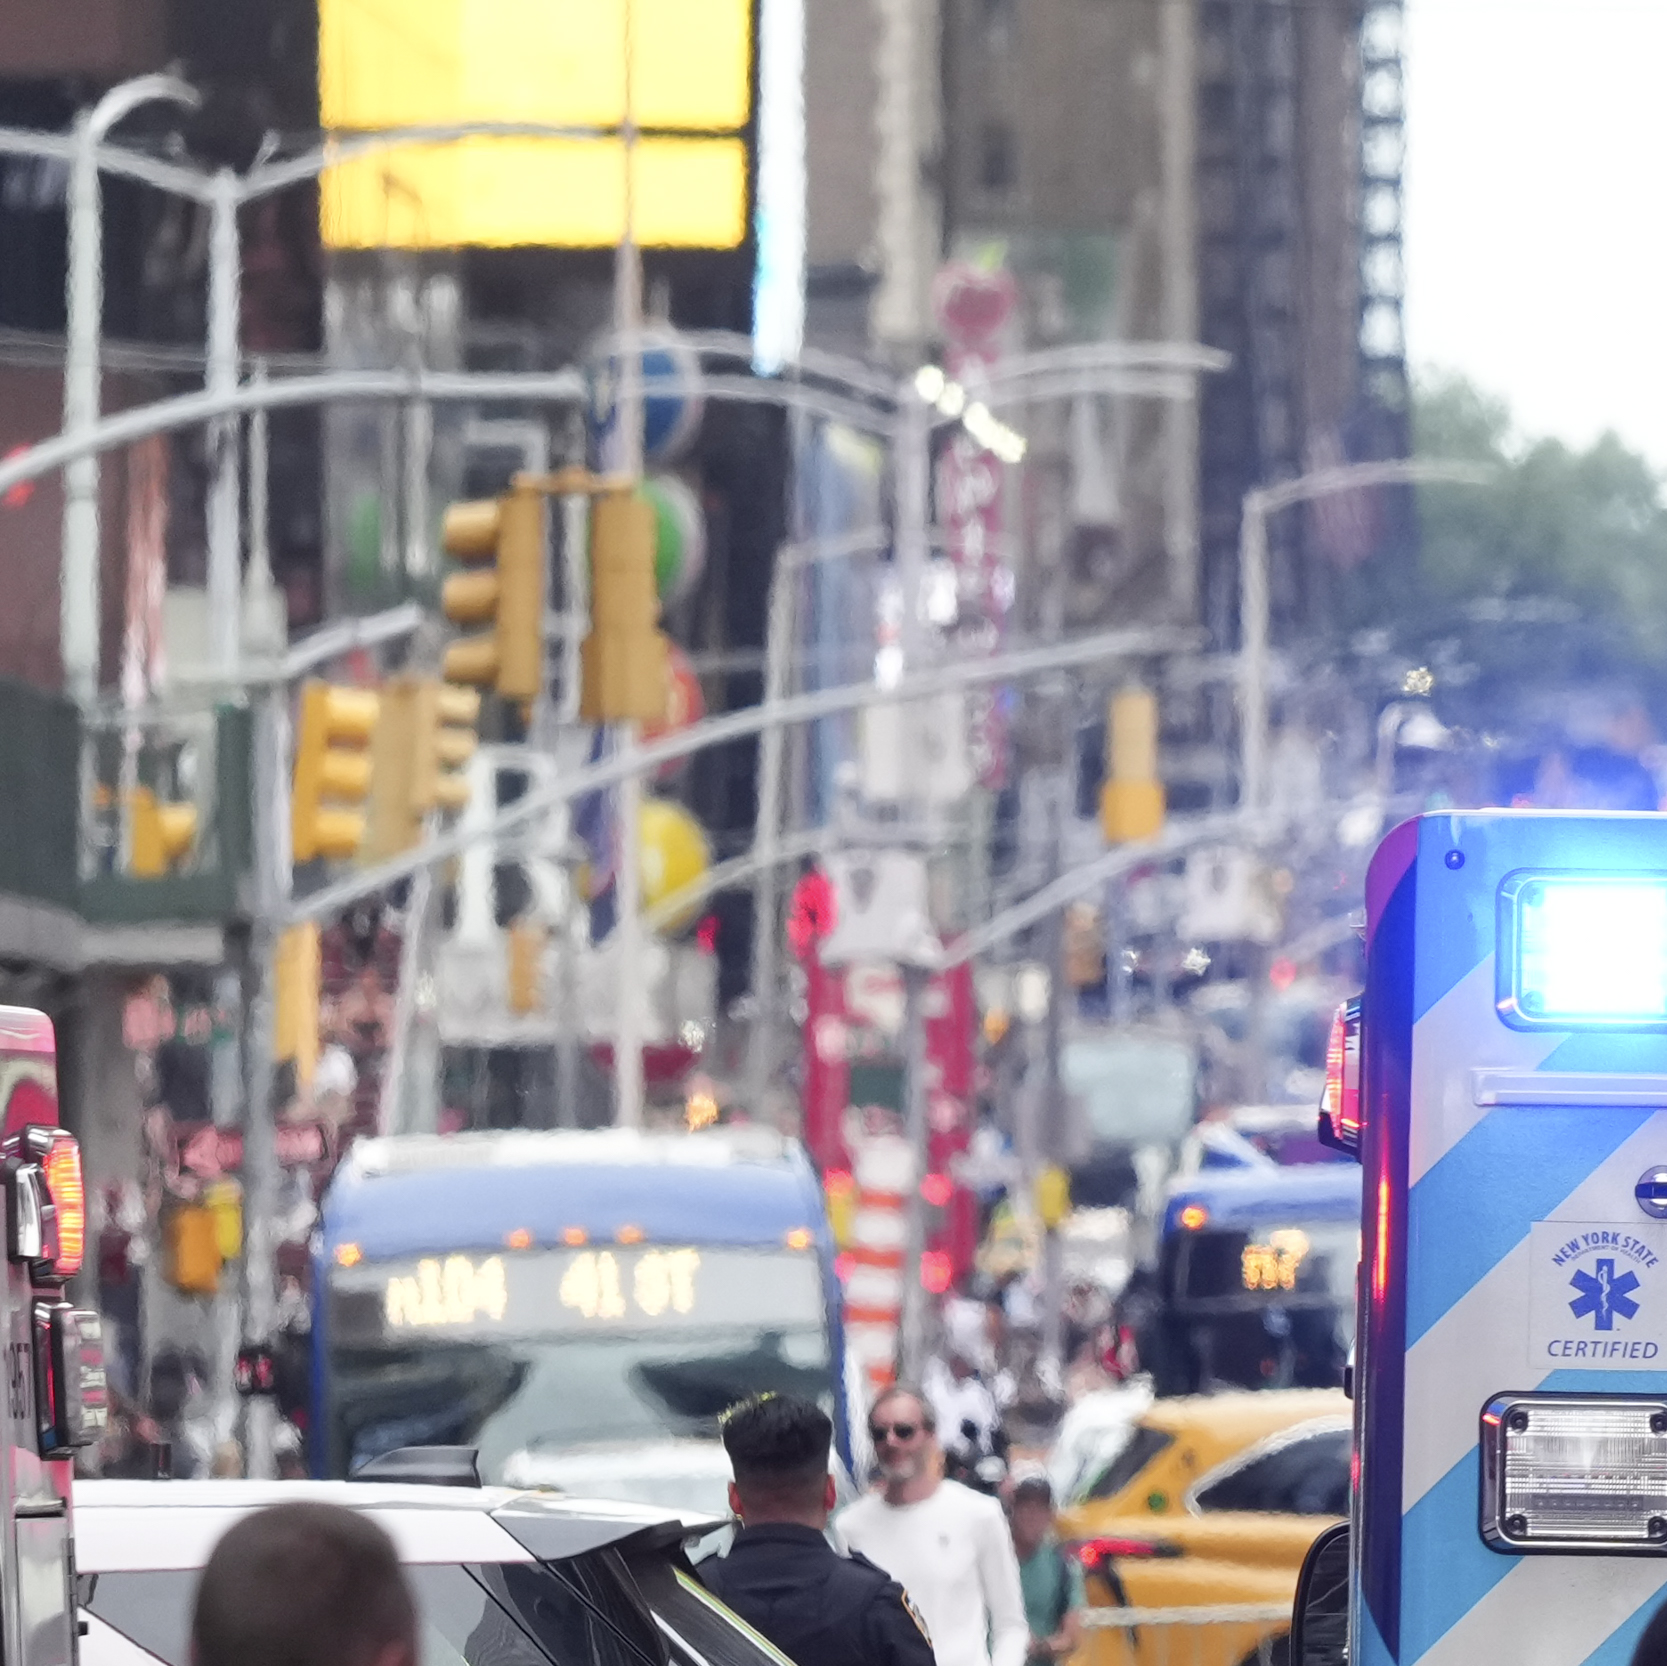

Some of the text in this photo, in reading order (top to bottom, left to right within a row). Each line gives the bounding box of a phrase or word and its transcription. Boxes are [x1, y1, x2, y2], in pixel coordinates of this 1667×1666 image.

[1551, 1231, 1659, 1269] NEW YORK STATE
[1571, 1244, 1609, 1262] DEPARTMENT
[1620, 1249, 1642, 1265] HEALTH
[1547, 1339, 1659, 1359] CERTIFIED
